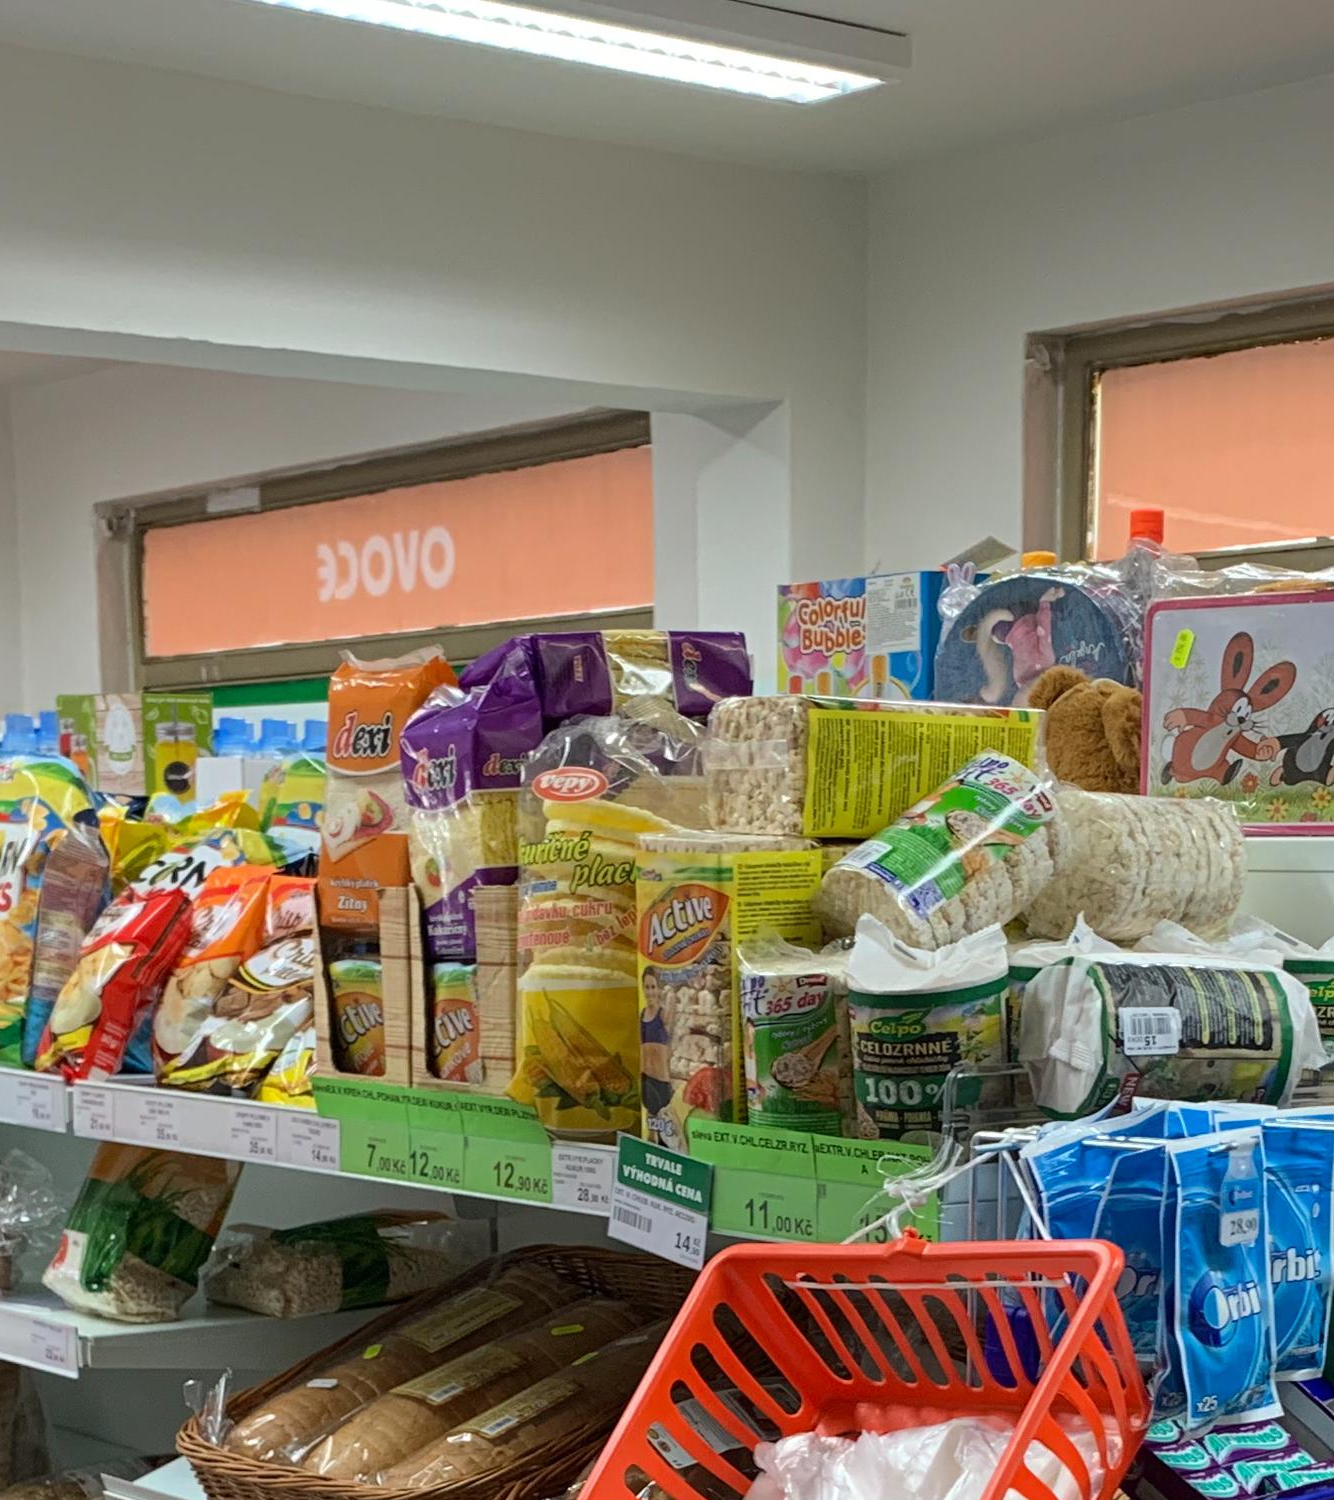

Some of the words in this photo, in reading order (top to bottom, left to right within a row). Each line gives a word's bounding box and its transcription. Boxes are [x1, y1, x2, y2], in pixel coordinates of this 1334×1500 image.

[802, 628, 866, 652] Bubble
[332, 710, 395, 759] dexi
[539, 774, 593, 794] vepy
[648, 894, 714, 955] Active
[765, 997, 793, 1015] 365
[860, 1037, 953, 1057] CELOZRNNÉ
[393, 1159, 407, 1175] Kč
[445, 1168, 460, 1184] Kč
[644, 1152, 683, 1176] TRVALE
[493, 1160, 531, 1190] 12,90
[533, 1176, 549, 1195] Kč
[621, 1163, 674, 1192] VÝHODNÁ
[674, 1181, 703, 1203] CENA
[745, 1198, 792, 1232] 11,00
[794, 1217, 813, 1236] Kč
[674, 1231, 691, 1252] 14
[1268, 1248, 1322, 1287] rbit
